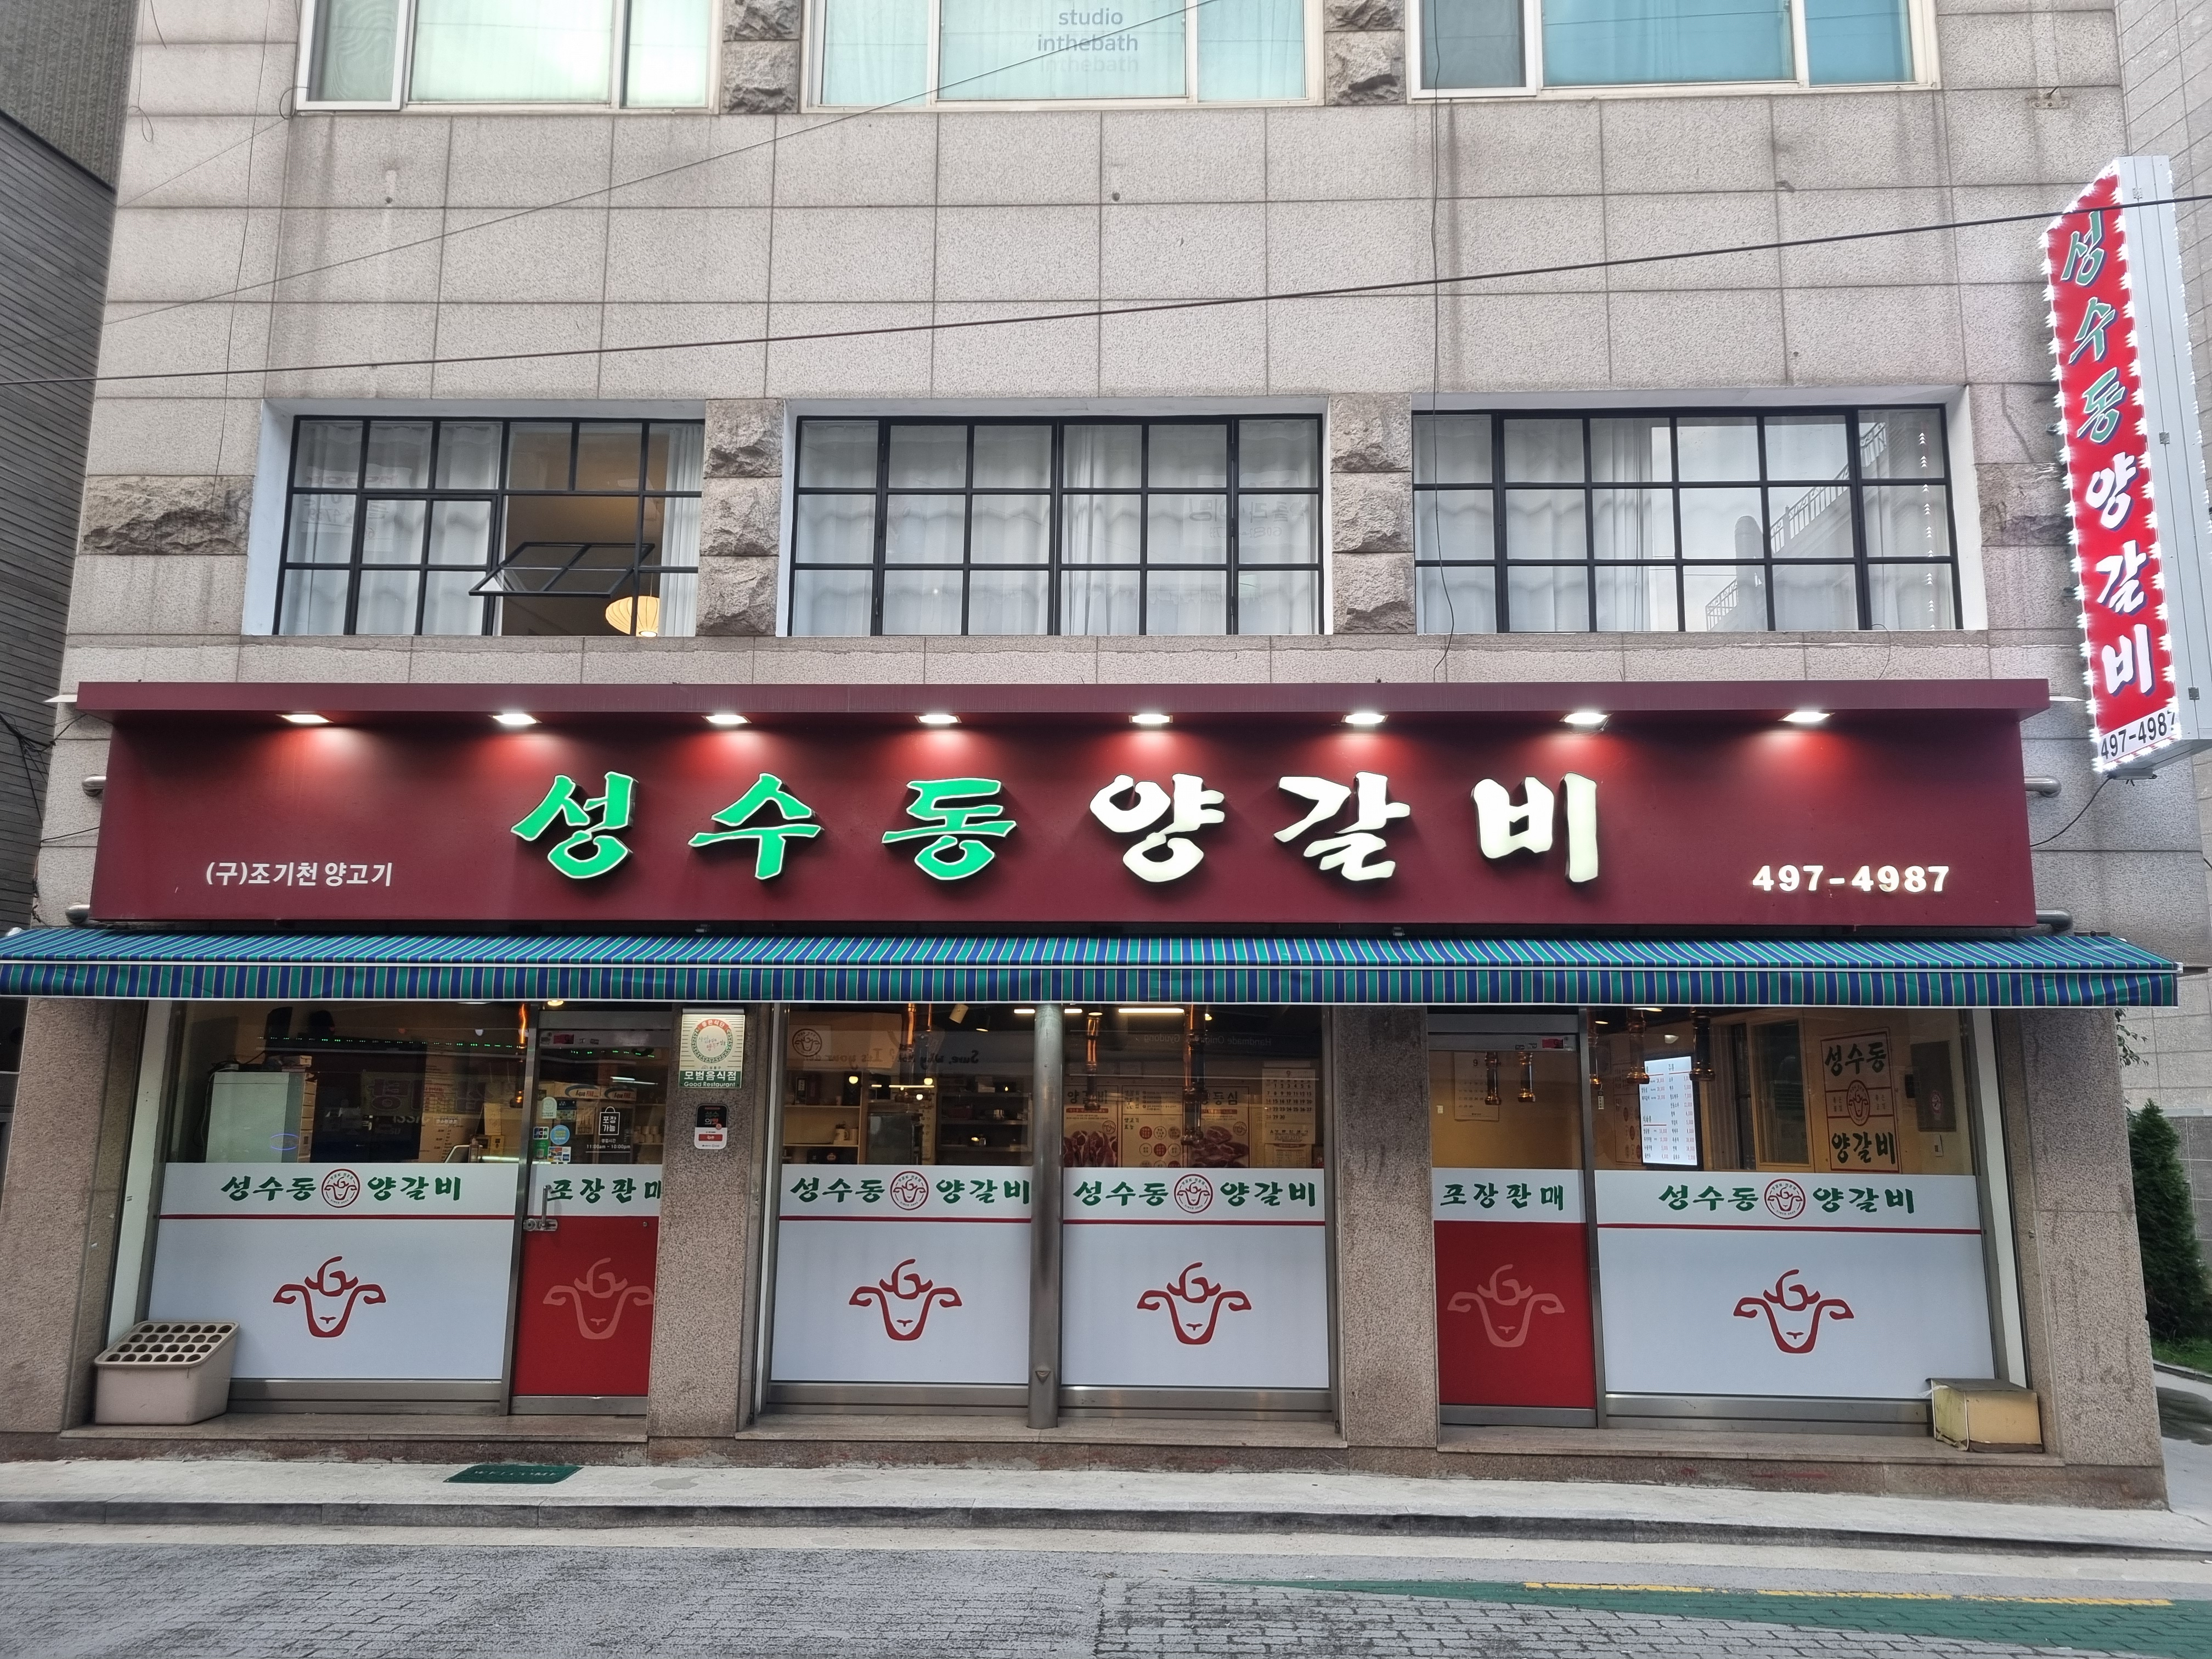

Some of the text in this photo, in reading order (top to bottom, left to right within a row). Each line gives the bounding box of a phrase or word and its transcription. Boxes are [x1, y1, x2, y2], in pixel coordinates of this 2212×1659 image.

[1058, 8, 1123, 25] studio
[1037, 34, 1138, 51] inthebath
[2061, 211, 2153, 694] 성수동 양갈비
[2101, 710, 2175, 760] 497-4987
[206, 862, 393, 887] (구)조기천 양고기
[1752, 865, 1949, 892] 497-4987
[1825, 1042, 1887, 1076] 성수동
[684, 1071, 736, 1081] 모범음식점
[1831, 1131, 1895, 1165] 양갈비
[221, 1175, 462, 1201] 성수동 양갈비
[790, 1177, 1030, 1204] 성수동 양갈비
[1073, 1181, 1316, 1207] 성수동 양갈비
[1440, 1182, 1564, 1211] 포장판매
[1658, 1184, 1914, 1214] 성수동 양갈비
